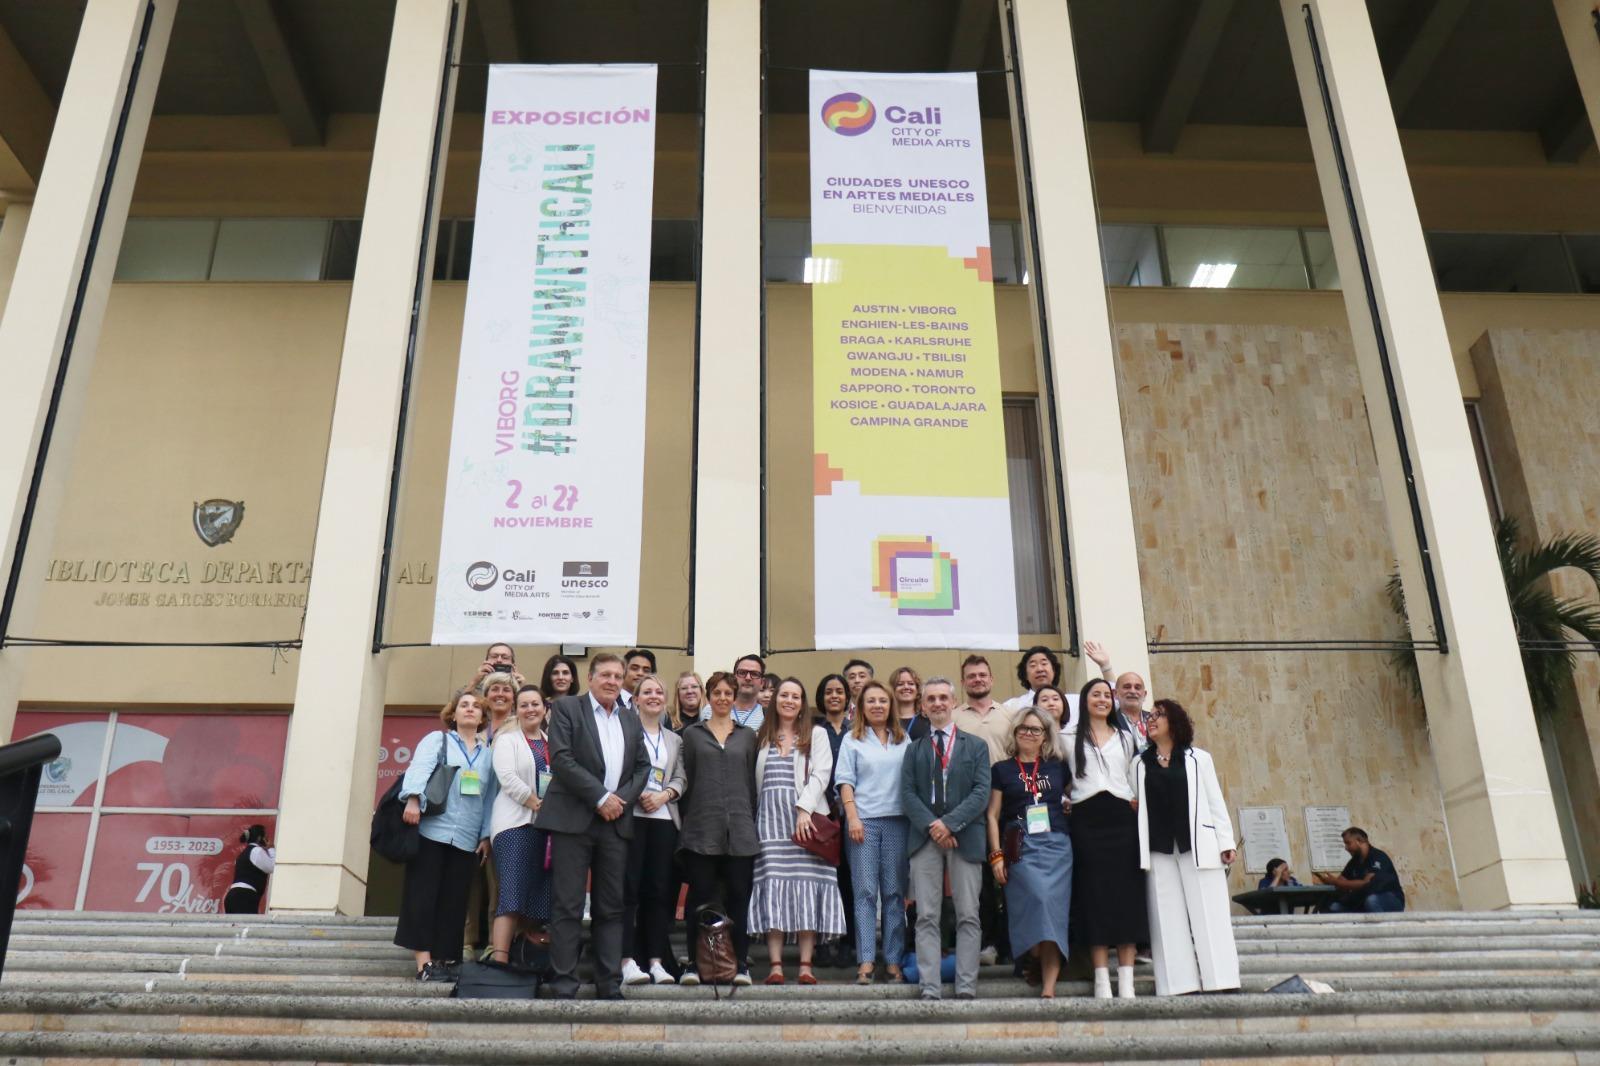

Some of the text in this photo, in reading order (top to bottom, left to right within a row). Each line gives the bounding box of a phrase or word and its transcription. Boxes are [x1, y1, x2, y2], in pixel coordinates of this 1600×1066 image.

[491, 107, 650, 126] EXPOSICIÓN
[884, 105, 942, 125] Cali
[891, 127, 942, 137] CITY OF
[892, 138, 971, 148] MEDIA ARTS
[826, 177, 970, 189] CIUDADES UNESCO
[823, 190, 975, 203] EN ARTES MEDIALES
[852, 203, 947, 215] BIENVENIDAS
[521, 144, 595, 456] #DRAWWITHCALI
[852, 305, 957, 315] AUSTIN VIBORG
[841, 320, 969, 331] ENGHIEN-LES-BAINS
[840, 335, 972, 347] BRAGA KARLSRUHE
[847, 352, 966, 362] GWANGJU TBILISI
[850, 368, 964, 378] MODENA NAMUR
[840, 384, 976, 395] SAPPORO TORONTO
[830, 400, 987, 412] KOSICE GUADALAJARA
[494, 370, 520, 456] VIBORG
[850, 417, 969, 428] CAMPINA GRANDE
[505, 479, 579, 512] 2 al 27
[493, 516, 594, 529] NOVIEMBRE
[45, 560, 190, 584] IBLIOTECA
[502, 569, 536, 583] Cali
[561, 580, 609, 588] unesco
[153, 840, 217, 852] 1953- 2023
[135, 862, 191, 903] 70
